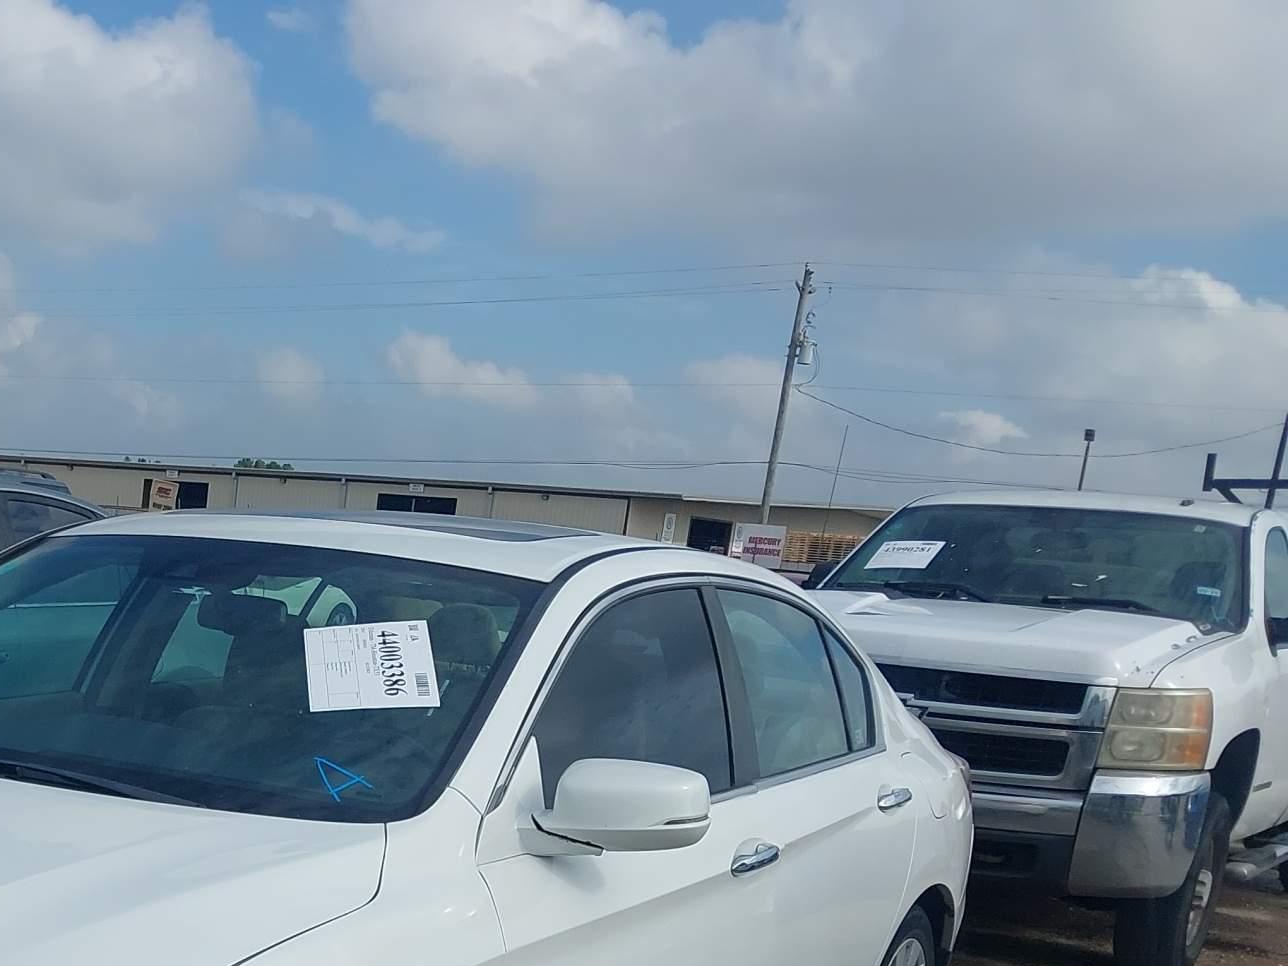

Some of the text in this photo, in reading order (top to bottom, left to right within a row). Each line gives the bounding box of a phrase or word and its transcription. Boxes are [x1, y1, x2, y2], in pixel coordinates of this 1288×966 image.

[748, 535, 782, 546] MERCURY
[743, 546, 782, 557] INSURANCE
[376, 630, 409, 697] 44003386
